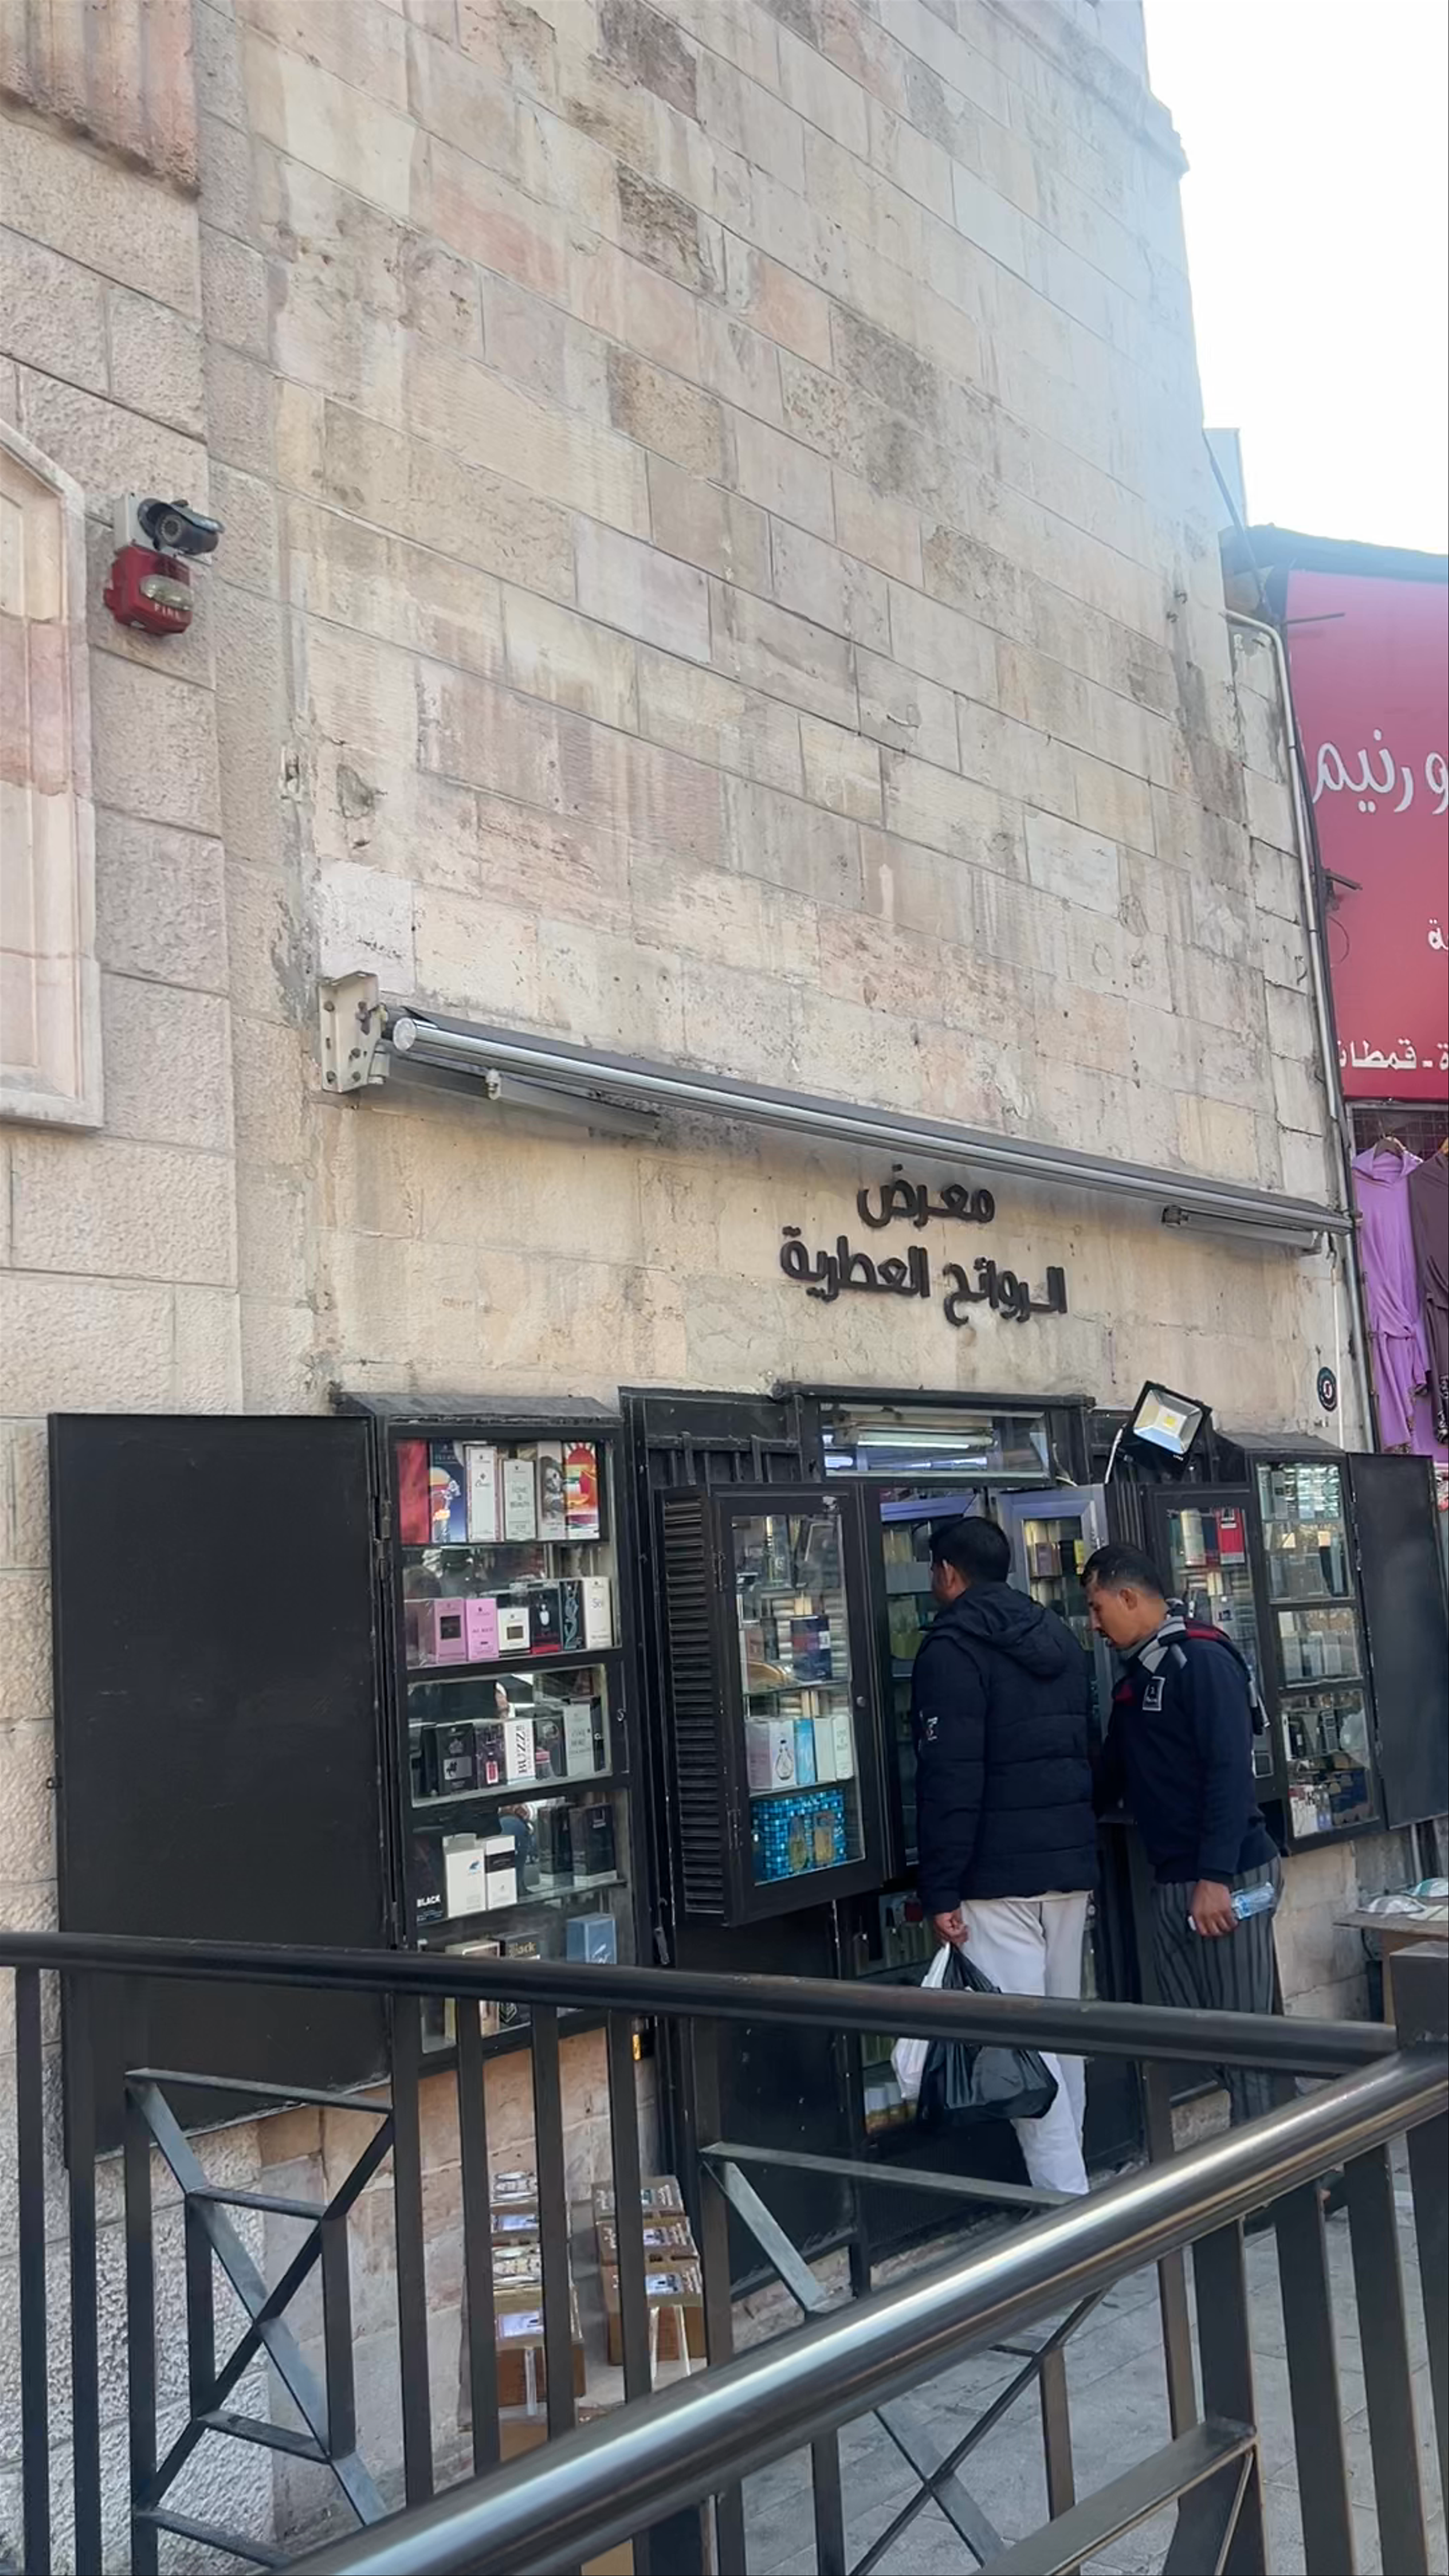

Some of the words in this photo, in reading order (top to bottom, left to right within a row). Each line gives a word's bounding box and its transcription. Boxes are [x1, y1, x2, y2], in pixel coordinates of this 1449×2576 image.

[857, 1164, 995, 1228] معرض
[780, 1225, 930, 1303] العطرية
[417, 1894, 441, 1907] BLACK
